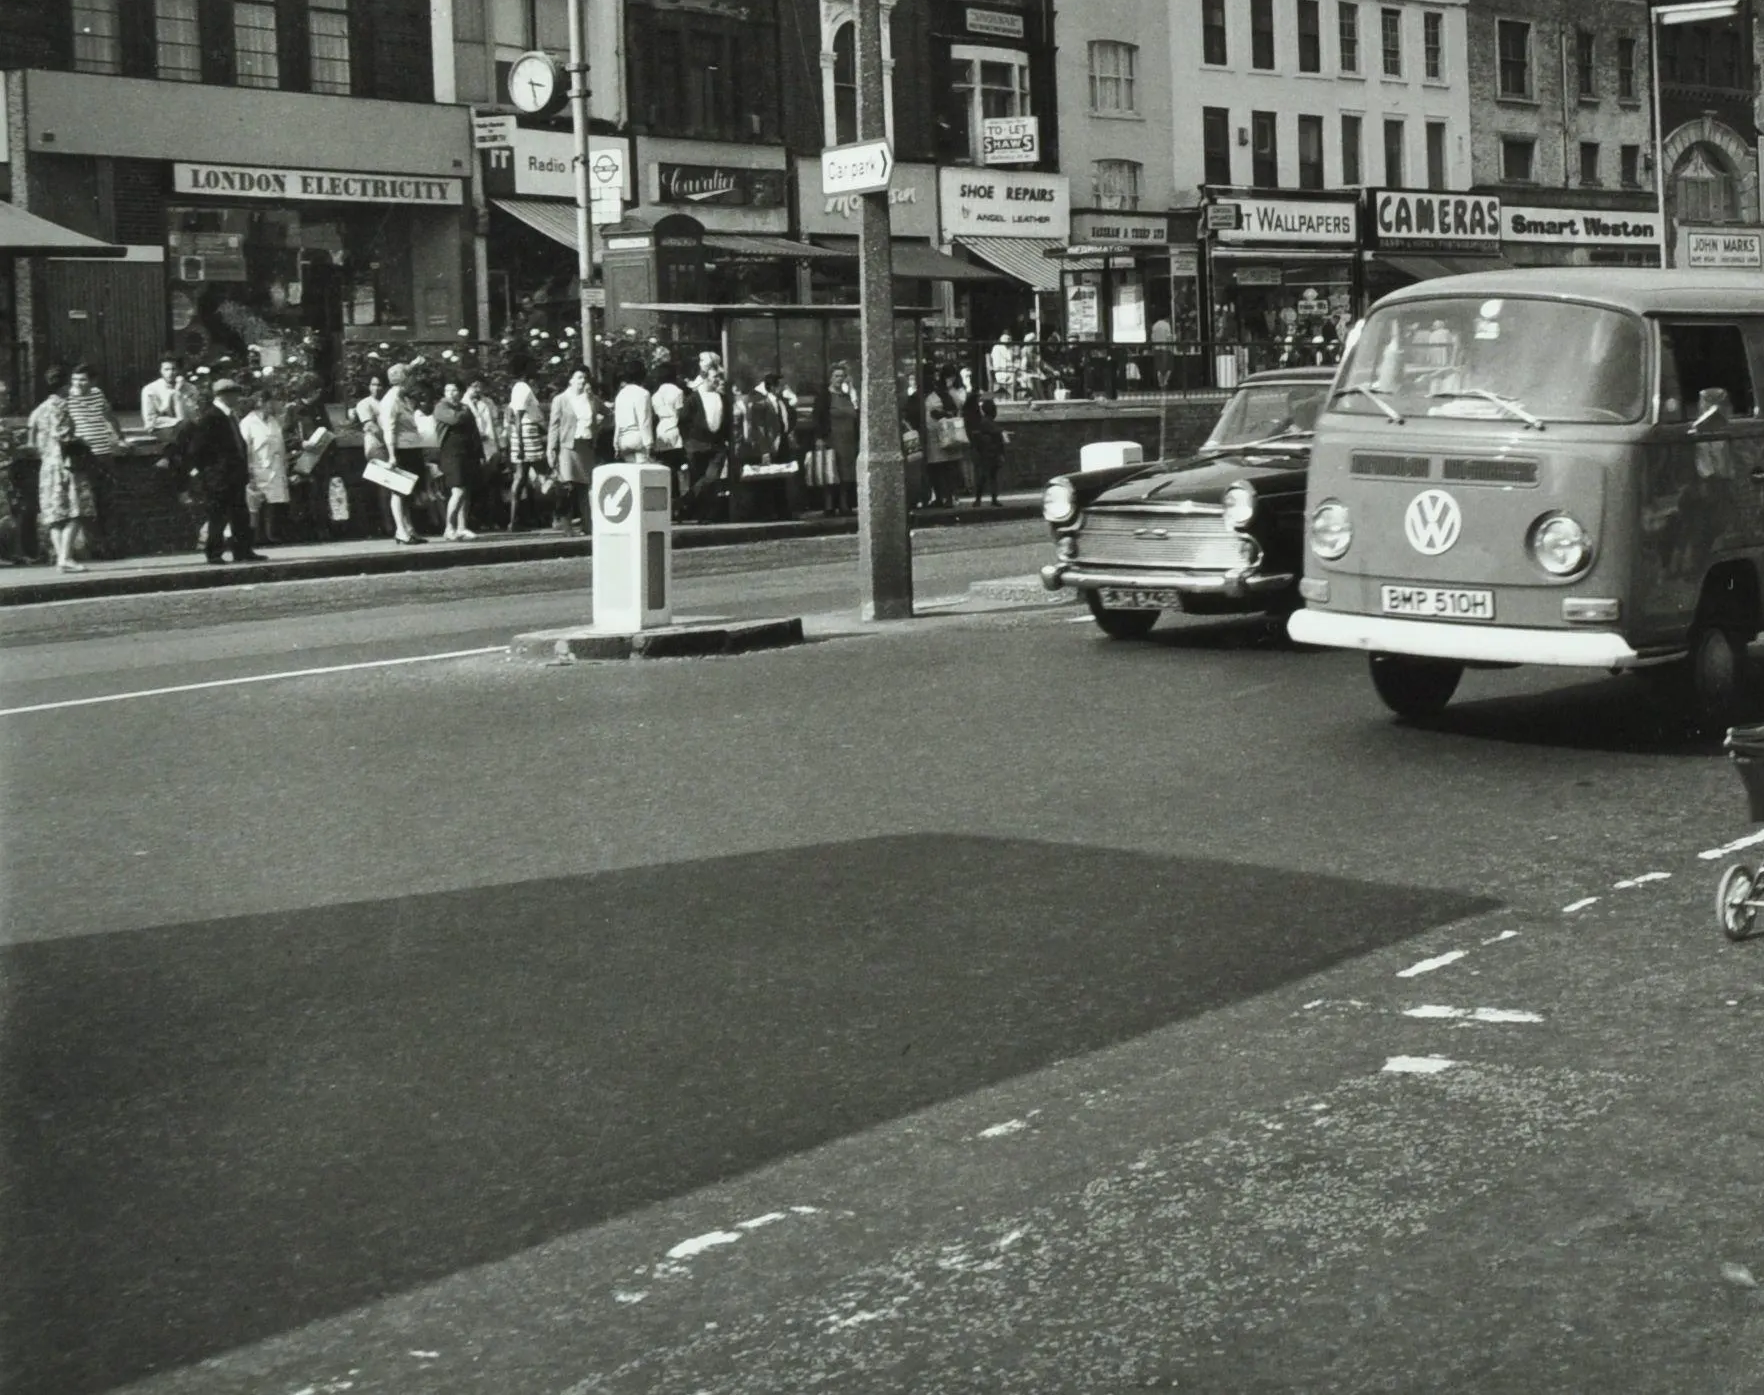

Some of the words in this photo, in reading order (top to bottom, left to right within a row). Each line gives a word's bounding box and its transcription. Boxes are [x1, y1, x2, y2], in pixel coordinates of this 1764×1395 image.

[528, 156, 566, 173] Radio
[827, 160, 850, 181] Car
[851, 156, 876, 179] park
[191, 168, 286, 193] LONDON
[297, 174, 451, 201] ELECTRICITY
[960, 184, 995, 200] SHOE
[1006, 186, 1055, 202] REPAIRS
[1012, 214, 1051, 224] LEATHER
[1256, 206, 1351, 234] WALLPAPERS
[1378, 195, 1499, 236] CAMERAS
[1511, 214, 1580, 236] Smart
[1583, 216, 1655, 238] Weston
[1693, 238, 1718, 252] JOHN
[1723, 238, 1755, 252] MARKS
[1406, 490, 1460, 554] VW
[1388, 588, 1428, 611] BMP
[1434, 592, 1487, 615] 510H
